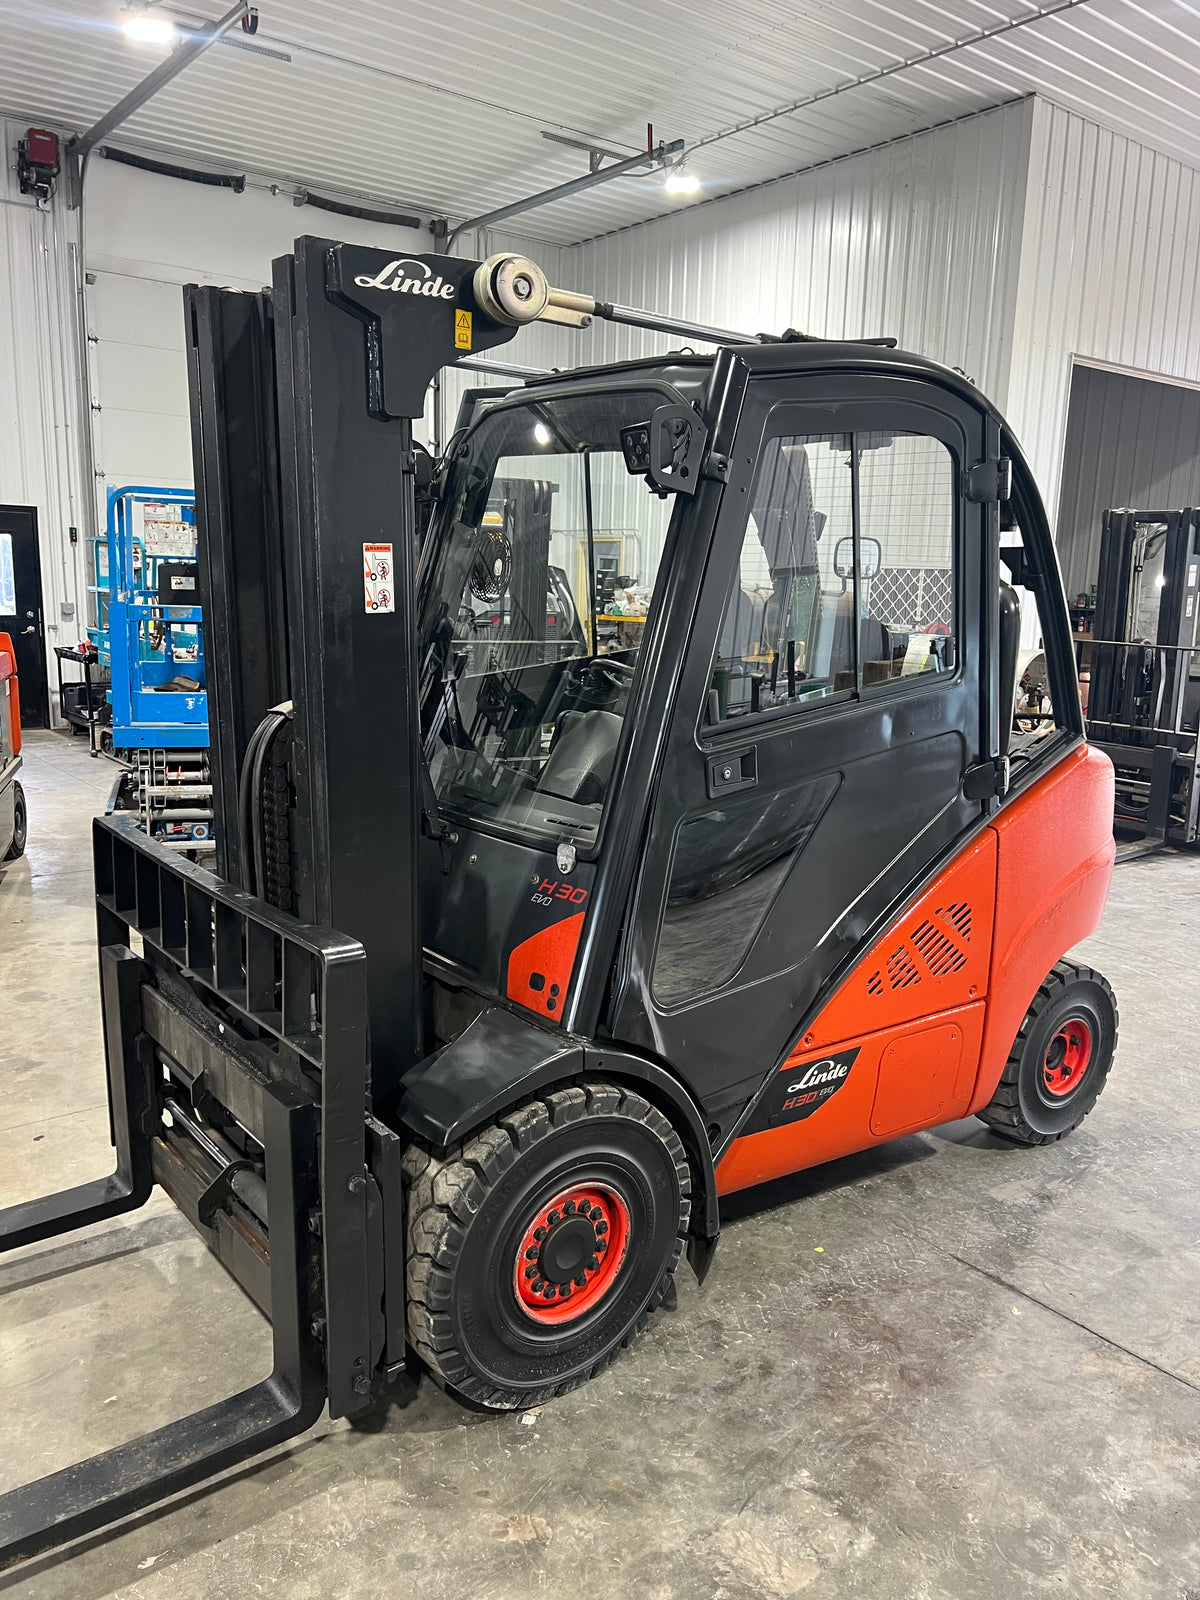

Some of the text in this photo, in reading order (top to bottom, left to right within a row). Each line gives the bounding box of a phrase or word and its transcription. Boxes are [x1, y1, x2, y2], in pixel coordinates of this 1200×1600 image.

[354, 259, 455, 299] Linde
[531, 893, 553, 906] EVO
[787, 1060, 848, 1093] Linde
[782, 1091, 818, 1110] H30
